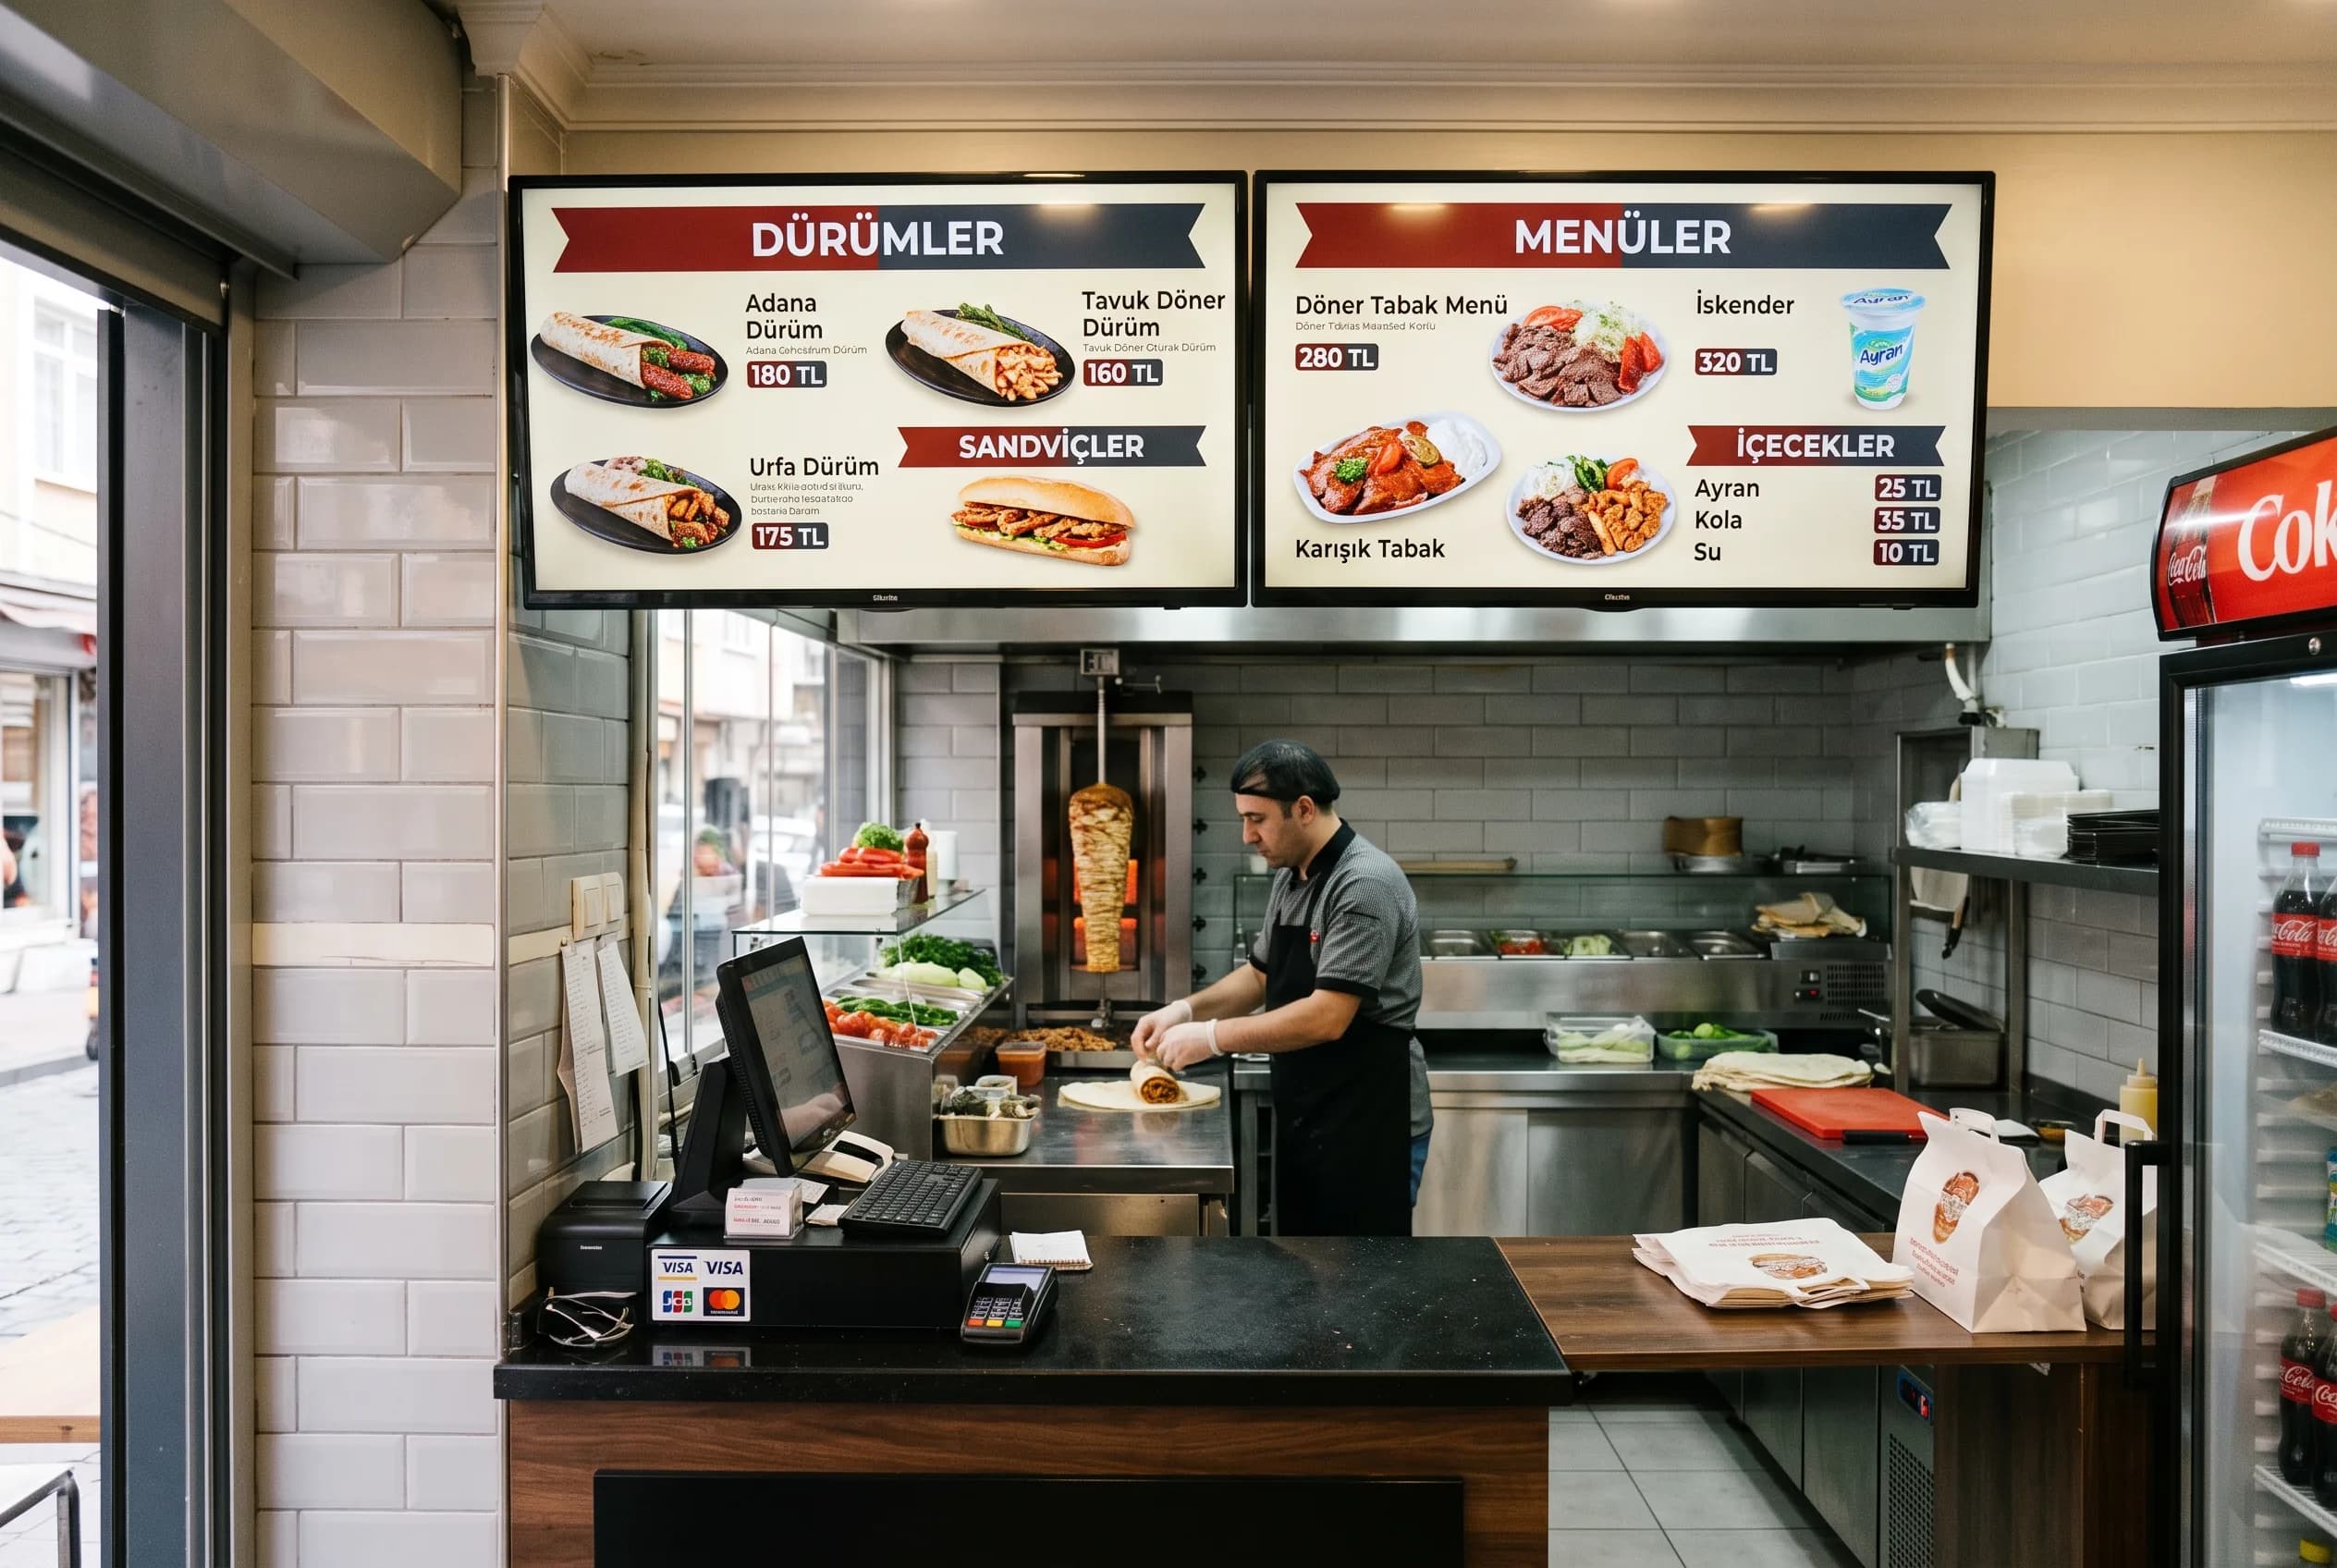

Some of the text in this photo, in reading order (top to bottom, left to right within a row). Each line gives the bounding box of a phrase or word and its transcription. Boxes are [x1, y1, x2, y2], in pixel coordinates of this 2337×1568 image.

[752, 212, 1004, 257] DÜRÜMLER
[1514, 210, 1731, 254] MENÜLER
[745, 293, 817, 312] Adana
[1082, 289, 1226, 310] Tavuk Döner
[1296, 295, 1508, 314] Döner Tabak Menü
[1696, 289, 1795, 314] İskender
[747, 320, 823, 339] Dürüm
[1083, 316, 1160, 337] Dürüm
[746, 346, 777, 355] Adana
[1083, 343, 1111, 352] Tavuk
[1299, 348, 1375, 368] 280 TL
[1860, 344, 1903, 366] Ayran
[1088, 362, 1159, 384] 160 TL
[1699, 352, 1773, 373] 320 TL
[751, 365, 824, 386] 180 TL
[959, 428, 1144, 465] SANDVİÇLER
[1737, 427, 1895, 464] İÇECEKLER
[750, 456, 879, 476] Urfa Dürüm
[1695, 479, 1760, 502] Ayran
[1878, 478, 1938, 498] 25 TL
[1695, 509, 1743, 530] Kola
[1878, 510, 1936, 531] 35 TL
[756, 526, 825, 546] 175 TL
[1295, 539, 1445, 563] Karışık Tabak
[1694, 543, 1721, 561] Su
[1878, 543, 1935, 562] 10 TL
[663, 1261, 743, 1275] VISA VISA
